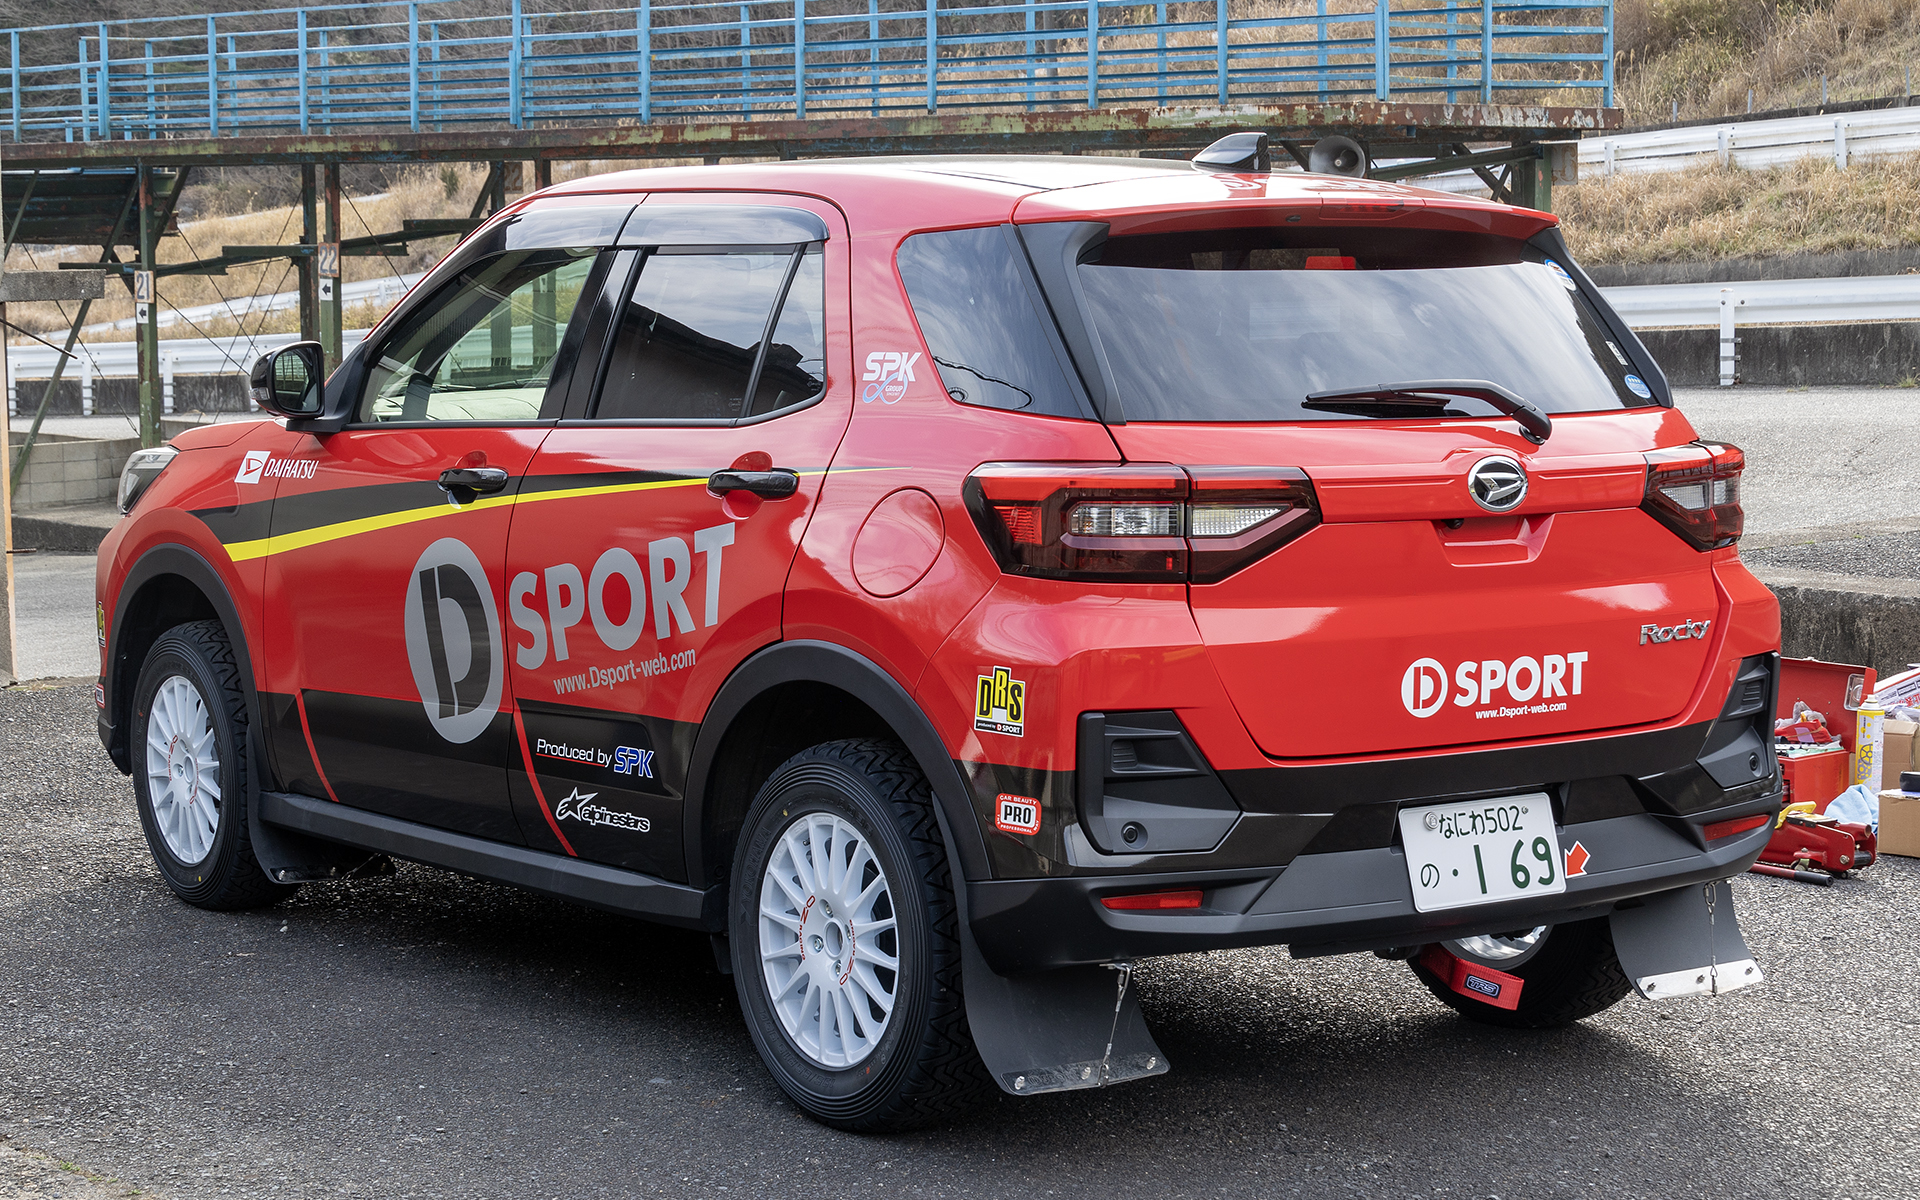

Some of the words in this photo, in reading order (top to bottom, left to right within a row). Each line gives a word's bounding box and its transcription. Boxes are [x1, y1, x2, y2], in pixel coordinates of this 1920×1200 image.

[319, 245, 338, 274] 22
[136, 273, 150, 300] 21
[862, 351, 922, 382] SPK
[263, 458, 320, 480] DAIHATSU
[508, 521, 736, 670] SPORT
[1639, 618, 1711, 646] Rocky
[553, 647, 696, 695] www.Dsport-web.com
[1453, 651, 1589, 708] SPORT
[979, 669, 1022, 721] DRS
[1475, 701, 1567, 720] www.Dsport-web.com
[1002, 724, 1021, 733] SPORT
[536, 738, 594, 762] Produced
[597, 748, 612, 768] by
[613, 745, 655, 779] SPK
[1003, 804, 1032, 825] PRO
[1013, 796, 1037, 805] BEAUTY
[581, 804, 651, 833] alpinestars
